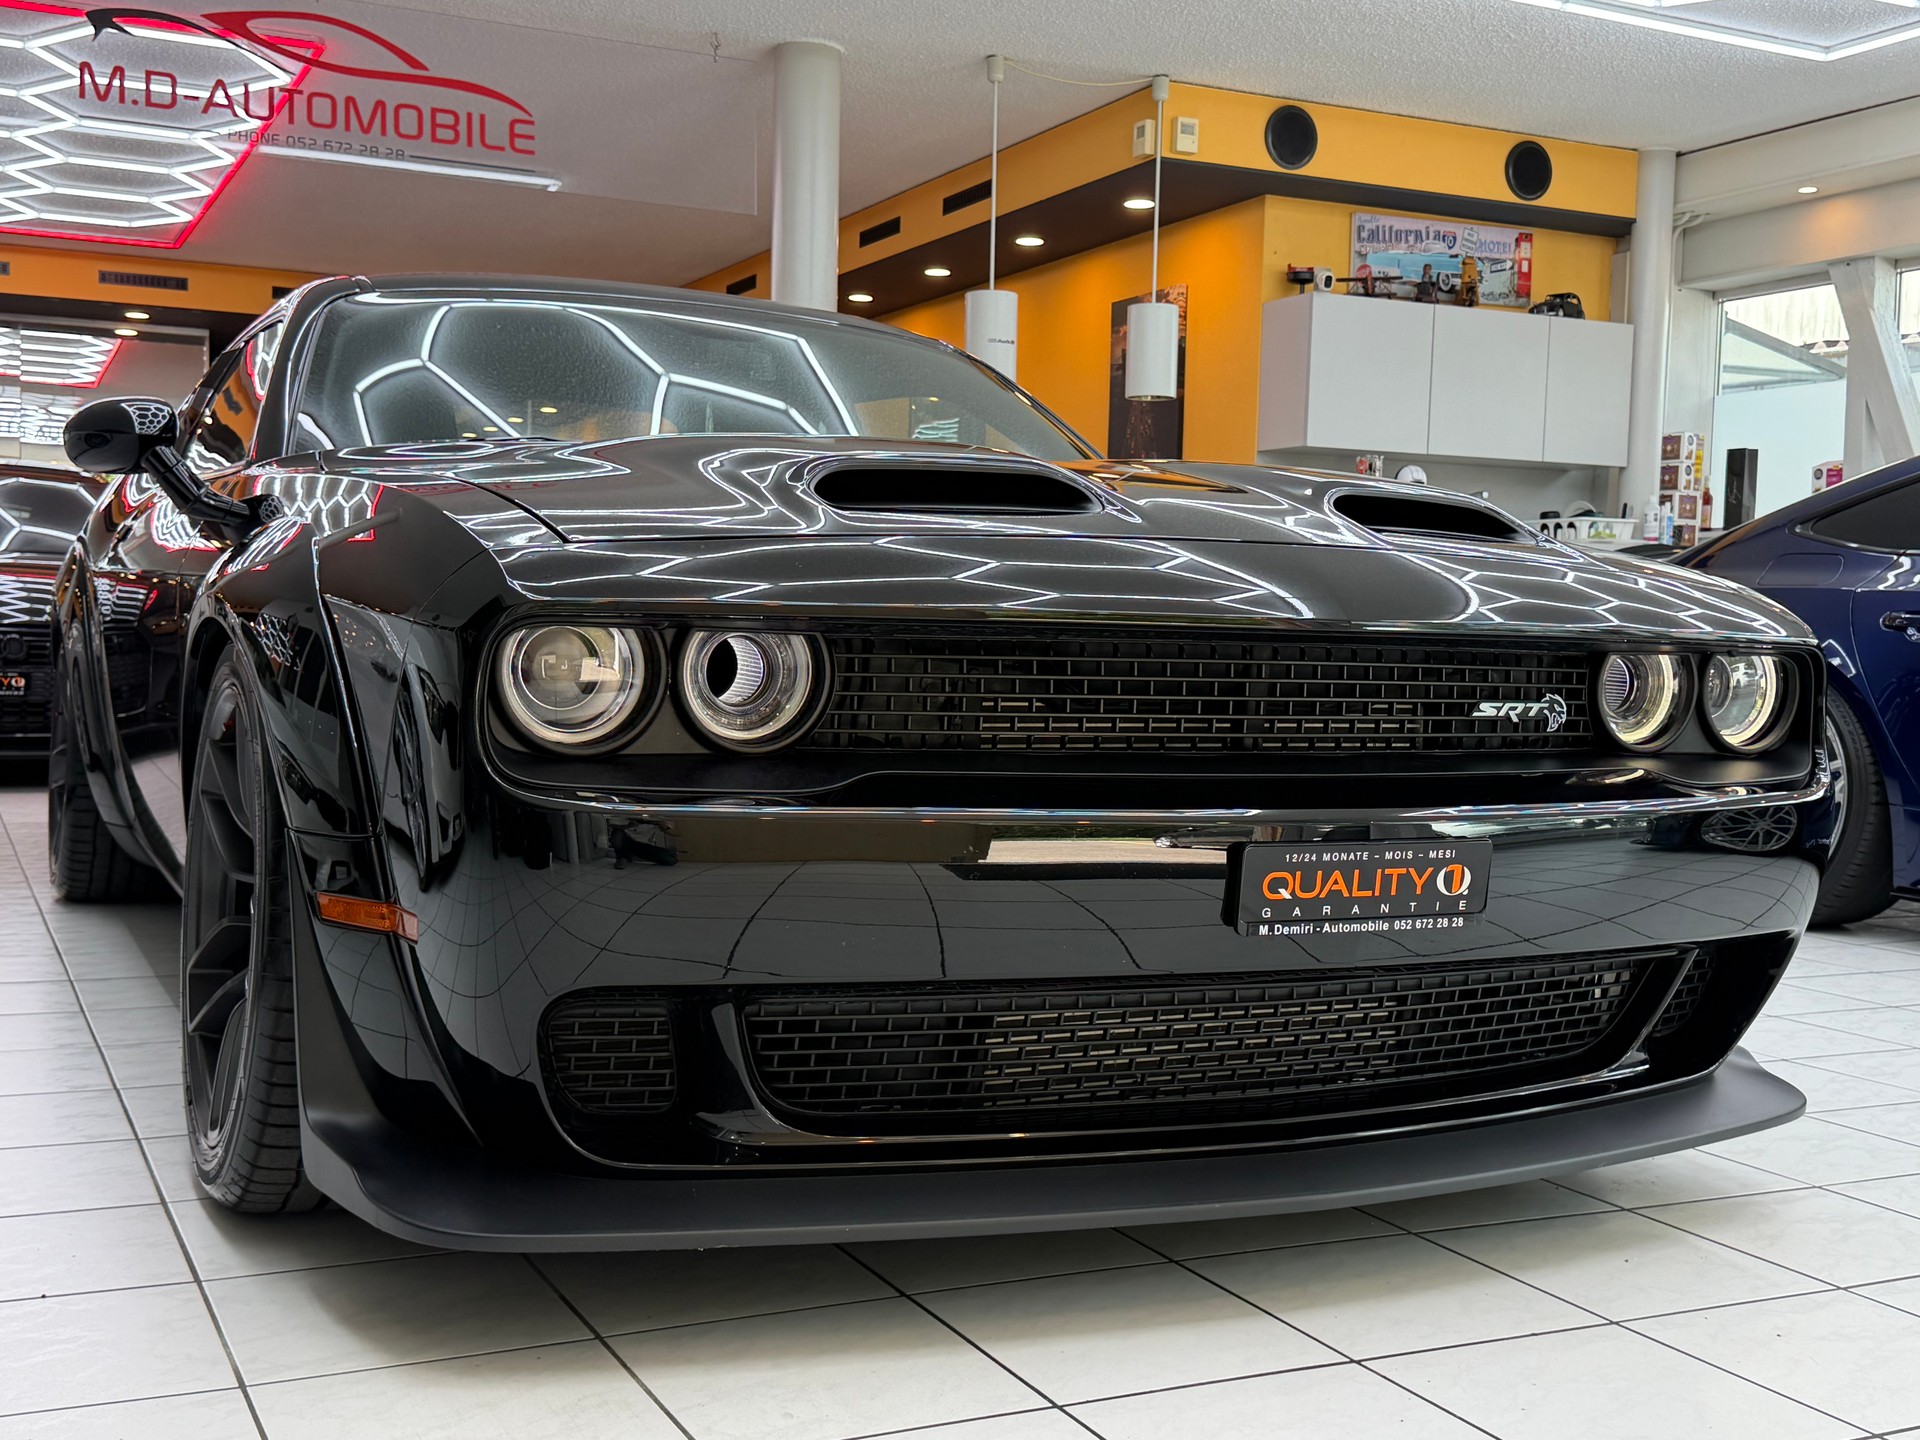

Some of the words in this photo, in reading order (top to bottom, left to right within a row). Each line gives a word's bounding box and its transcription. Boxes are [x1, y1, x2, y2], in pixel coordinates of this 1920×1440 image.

[227, 129, 281, 145] PHONE
[286, 135, 317, 149] 052
[323, 140, 353, 153] 672
[359, 144, 380, 157] 28
[386, 148, 405, 160] 28
[1357, 224, 1441, 244] California
[1472, 702, 1550, 722] SRT
[1285, 853, 1317, 862] 12/24
[1322, 851, 1369, 862] MONATE
[1385, 851, 1413, 860] MOIS
[1429, 849, 1456, 858] MESI
[1262, 867, 1434, 900] QUALITY
[1261, 900, 1467, 918] GARANTIE
[1394, 920, 1412, 930] 052
[1415, 919, 1433, 929] 672
[1436, 918, 1449, 928] 28
[1451, 917, 1464, 927] 28
